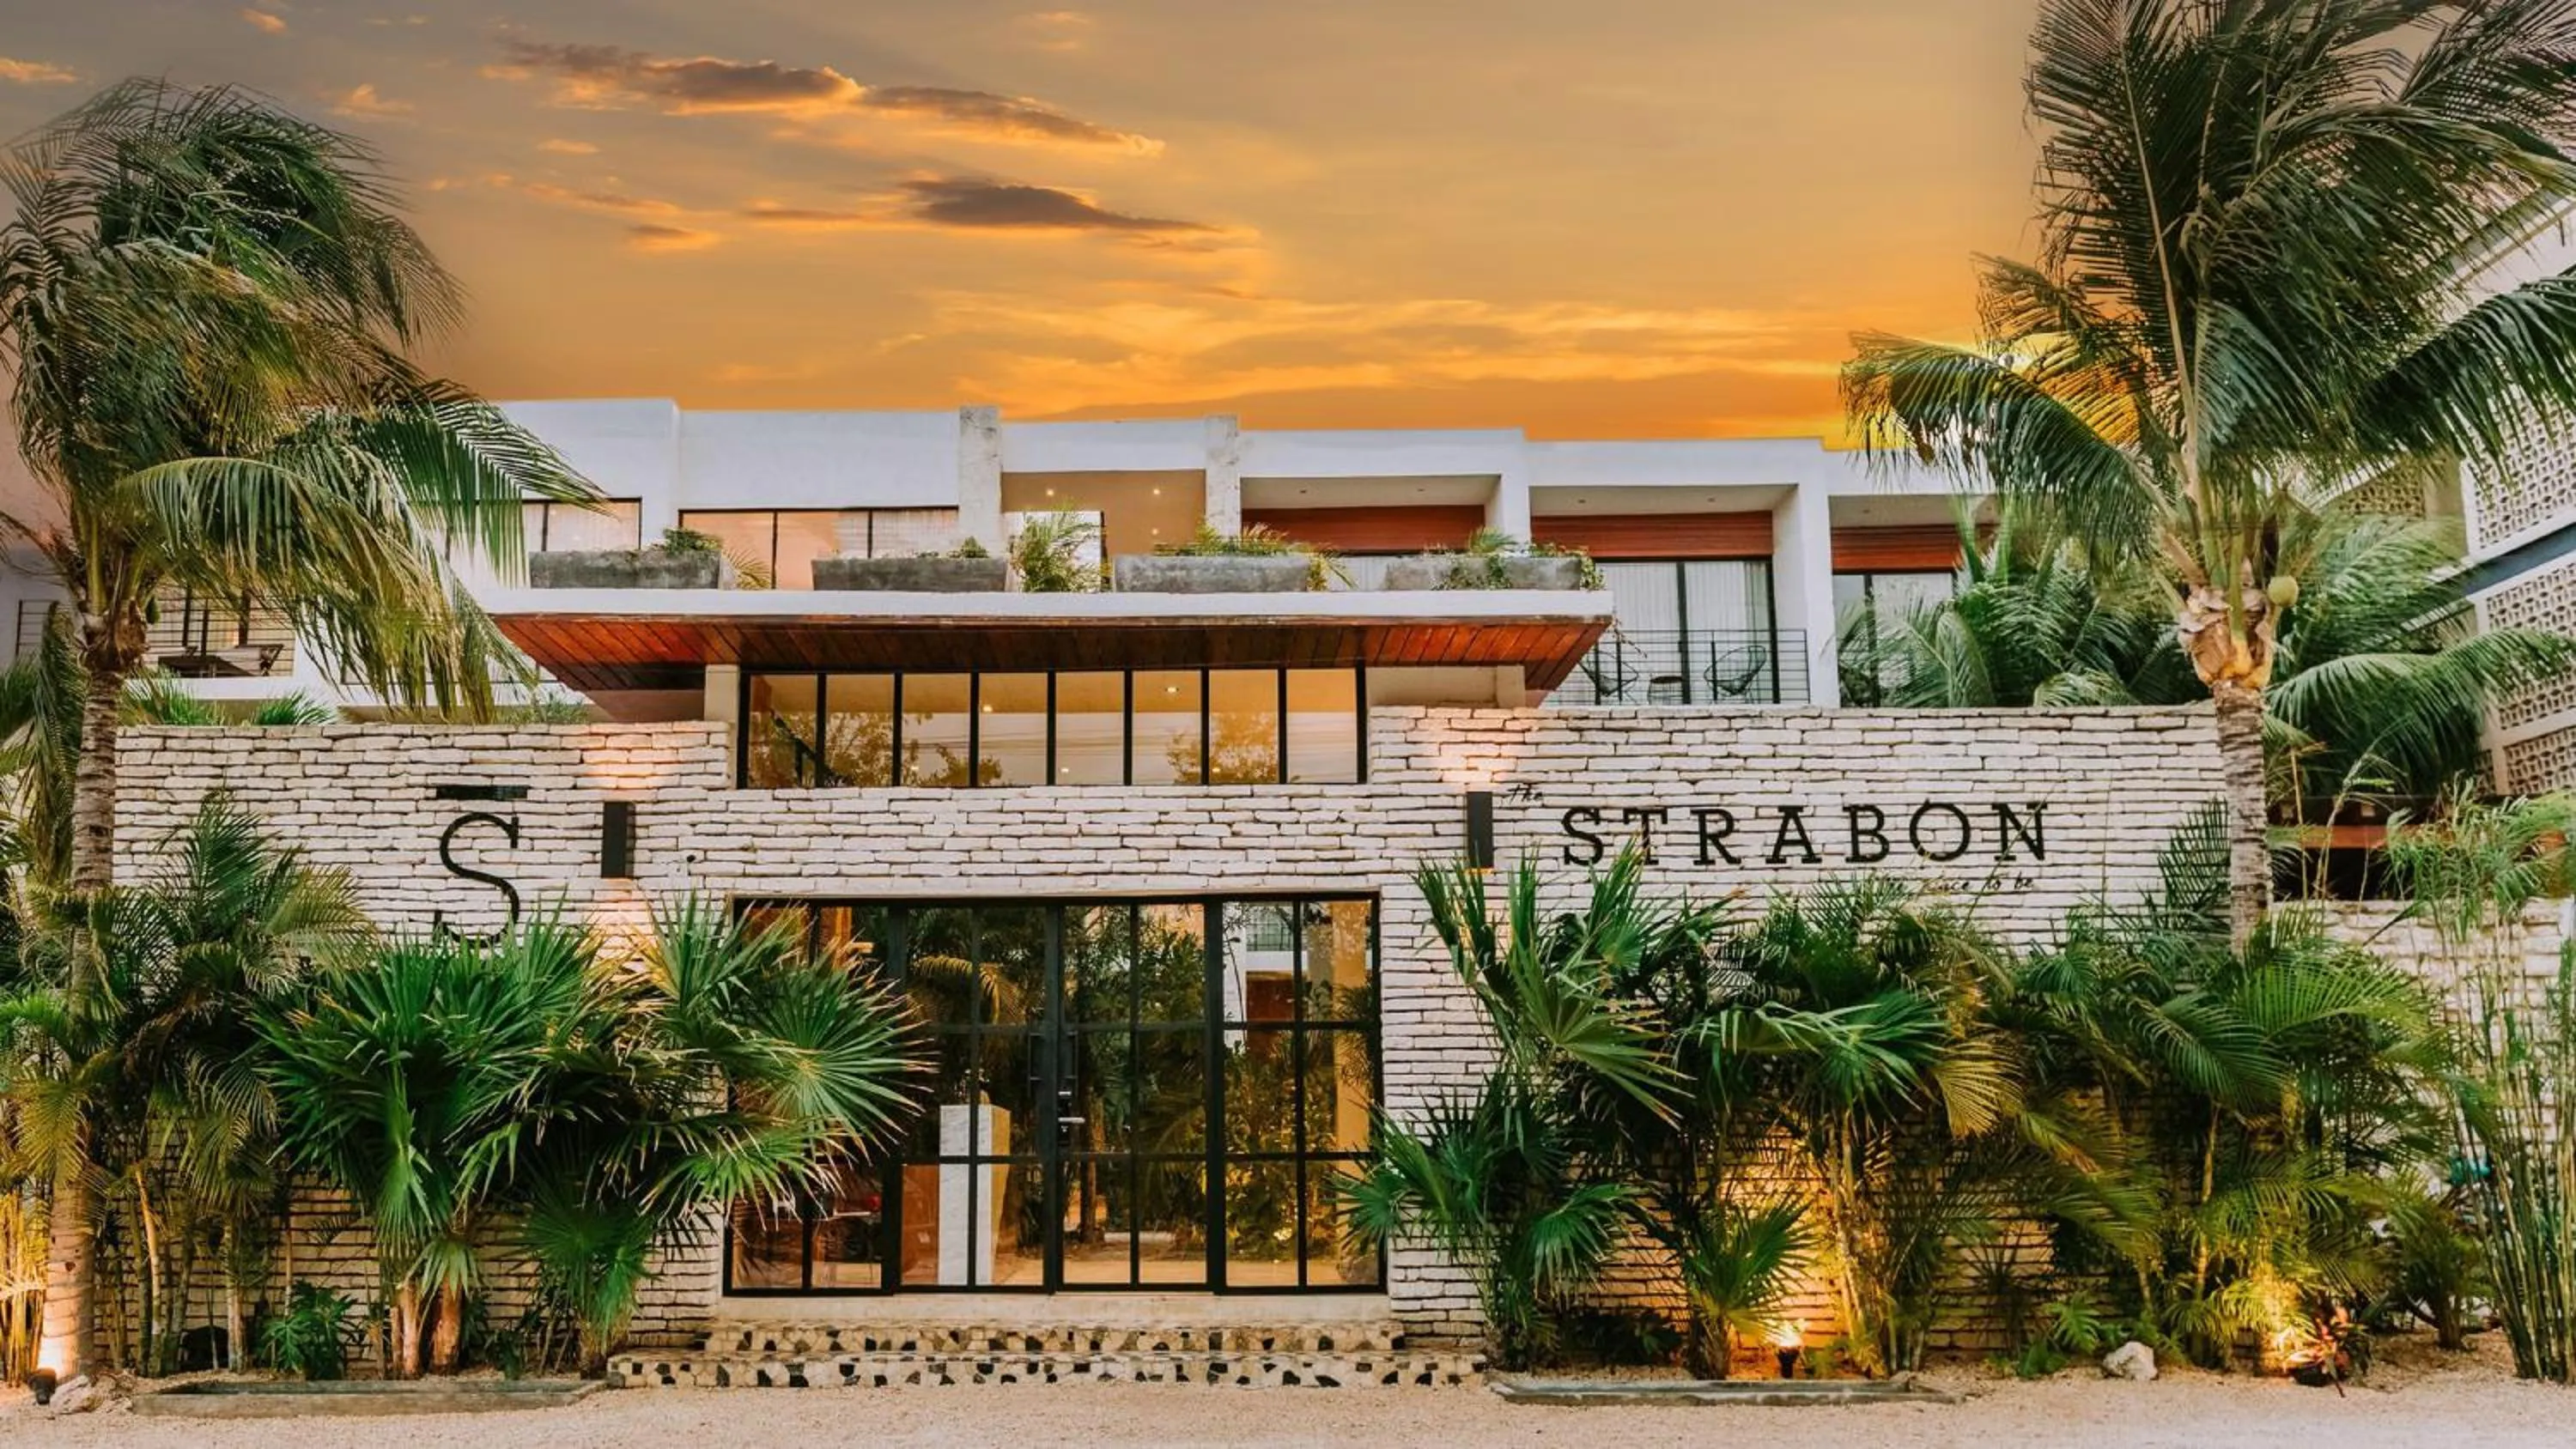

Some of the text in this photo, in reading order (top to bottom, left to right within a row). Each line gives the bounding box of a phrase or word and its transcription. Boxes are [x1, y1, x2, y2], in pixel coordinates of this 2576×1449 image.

[1561, 799, 2048, 866] STRABON
[434, 811, 520, 945] S
[2014, 870, 2035, 890] be
